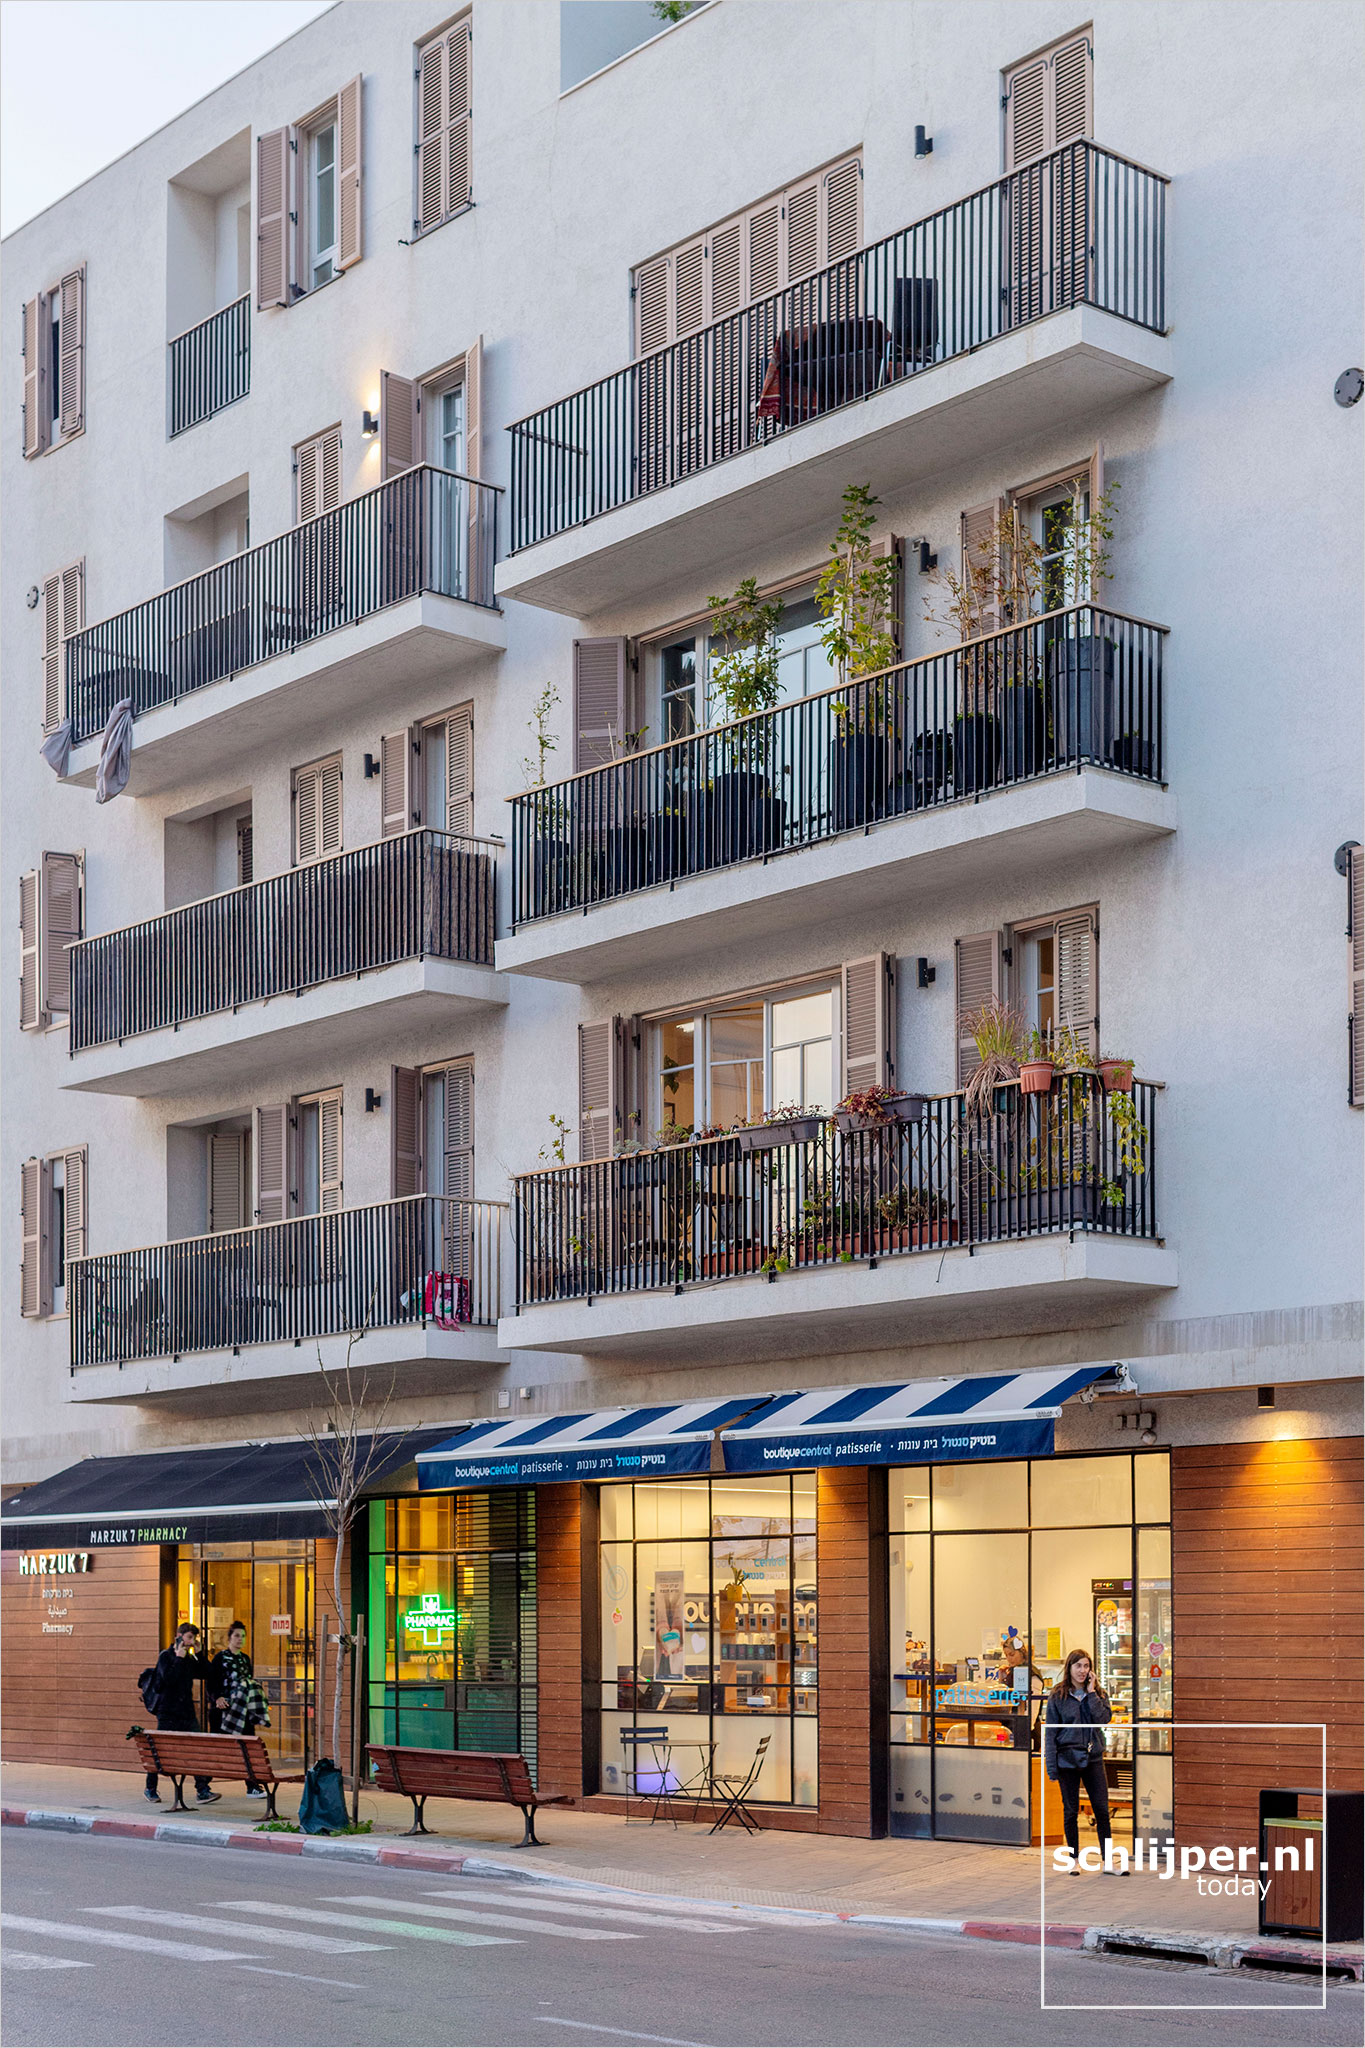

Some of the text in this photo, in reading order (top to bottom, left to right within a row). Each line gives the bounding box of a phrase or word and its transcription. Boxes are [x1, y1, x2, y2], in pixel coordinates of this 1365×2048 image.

[835, 1441, 882, 1457] patisserie
[923, 1439, 938, 1450] בית
[521, 1460, 563, 1476] patisserie
[600, 1458, 613, 1469] בית
[90, 1526, 188, 1543] MARZUK 7 PHARMACY
[19, 1552, 88, 1575] MARZUK 7
[42, 1622, 74, 1636] Pharmacy
[272, 1620, 290, 1630] פתוח
[935, 1685, 1020, 1709] patisserie
